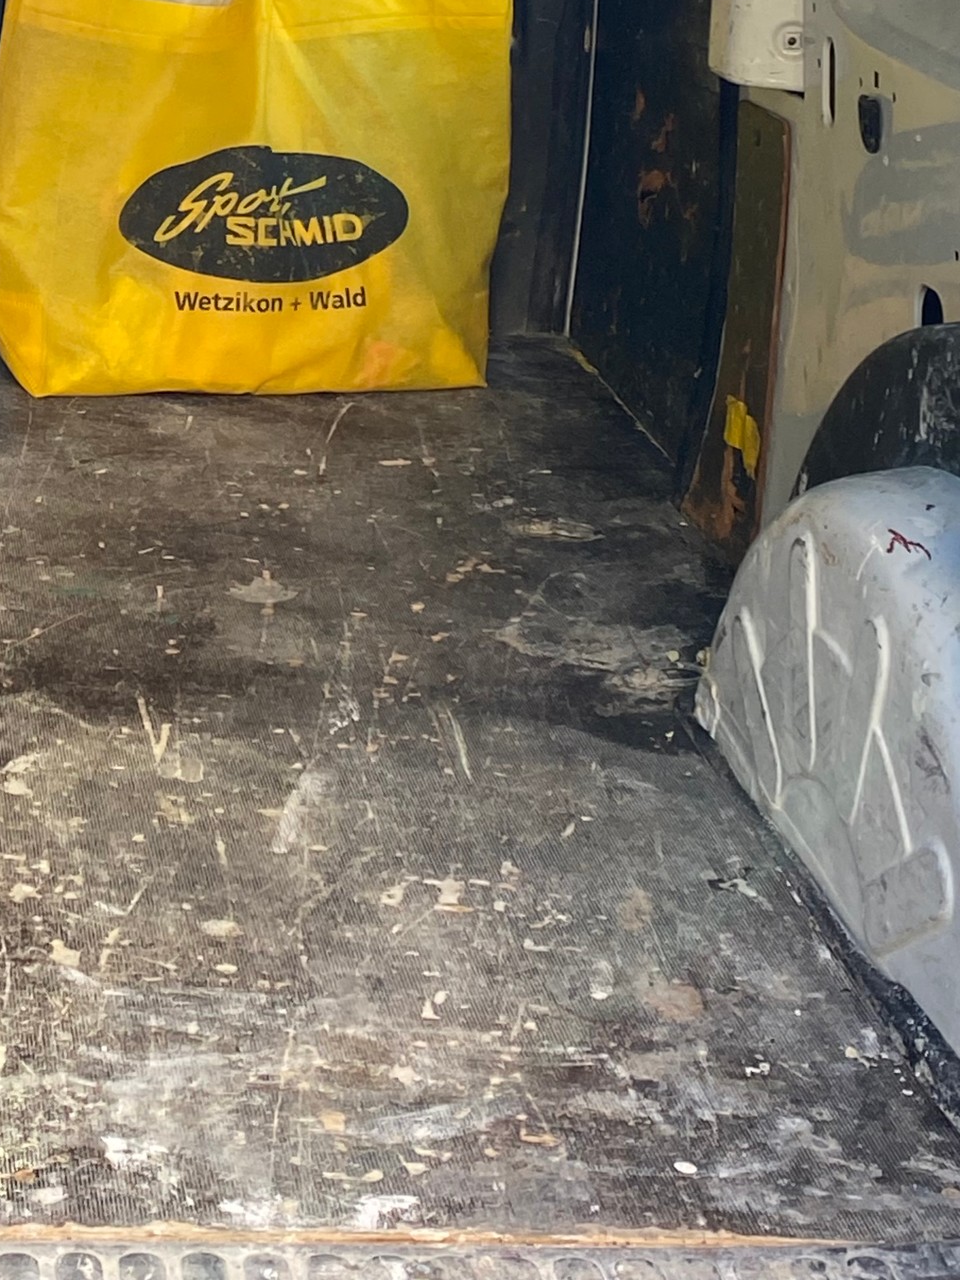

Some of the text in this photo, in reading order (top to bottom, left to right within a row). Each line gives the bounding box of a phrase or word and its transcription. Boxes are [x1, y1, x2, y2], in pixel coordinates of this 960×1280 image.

[153, 172, 326, 242] Sport
[225, 213, 364, 247] SCHMID
[174, 286, 367, 312] Wetzikon + Wald
